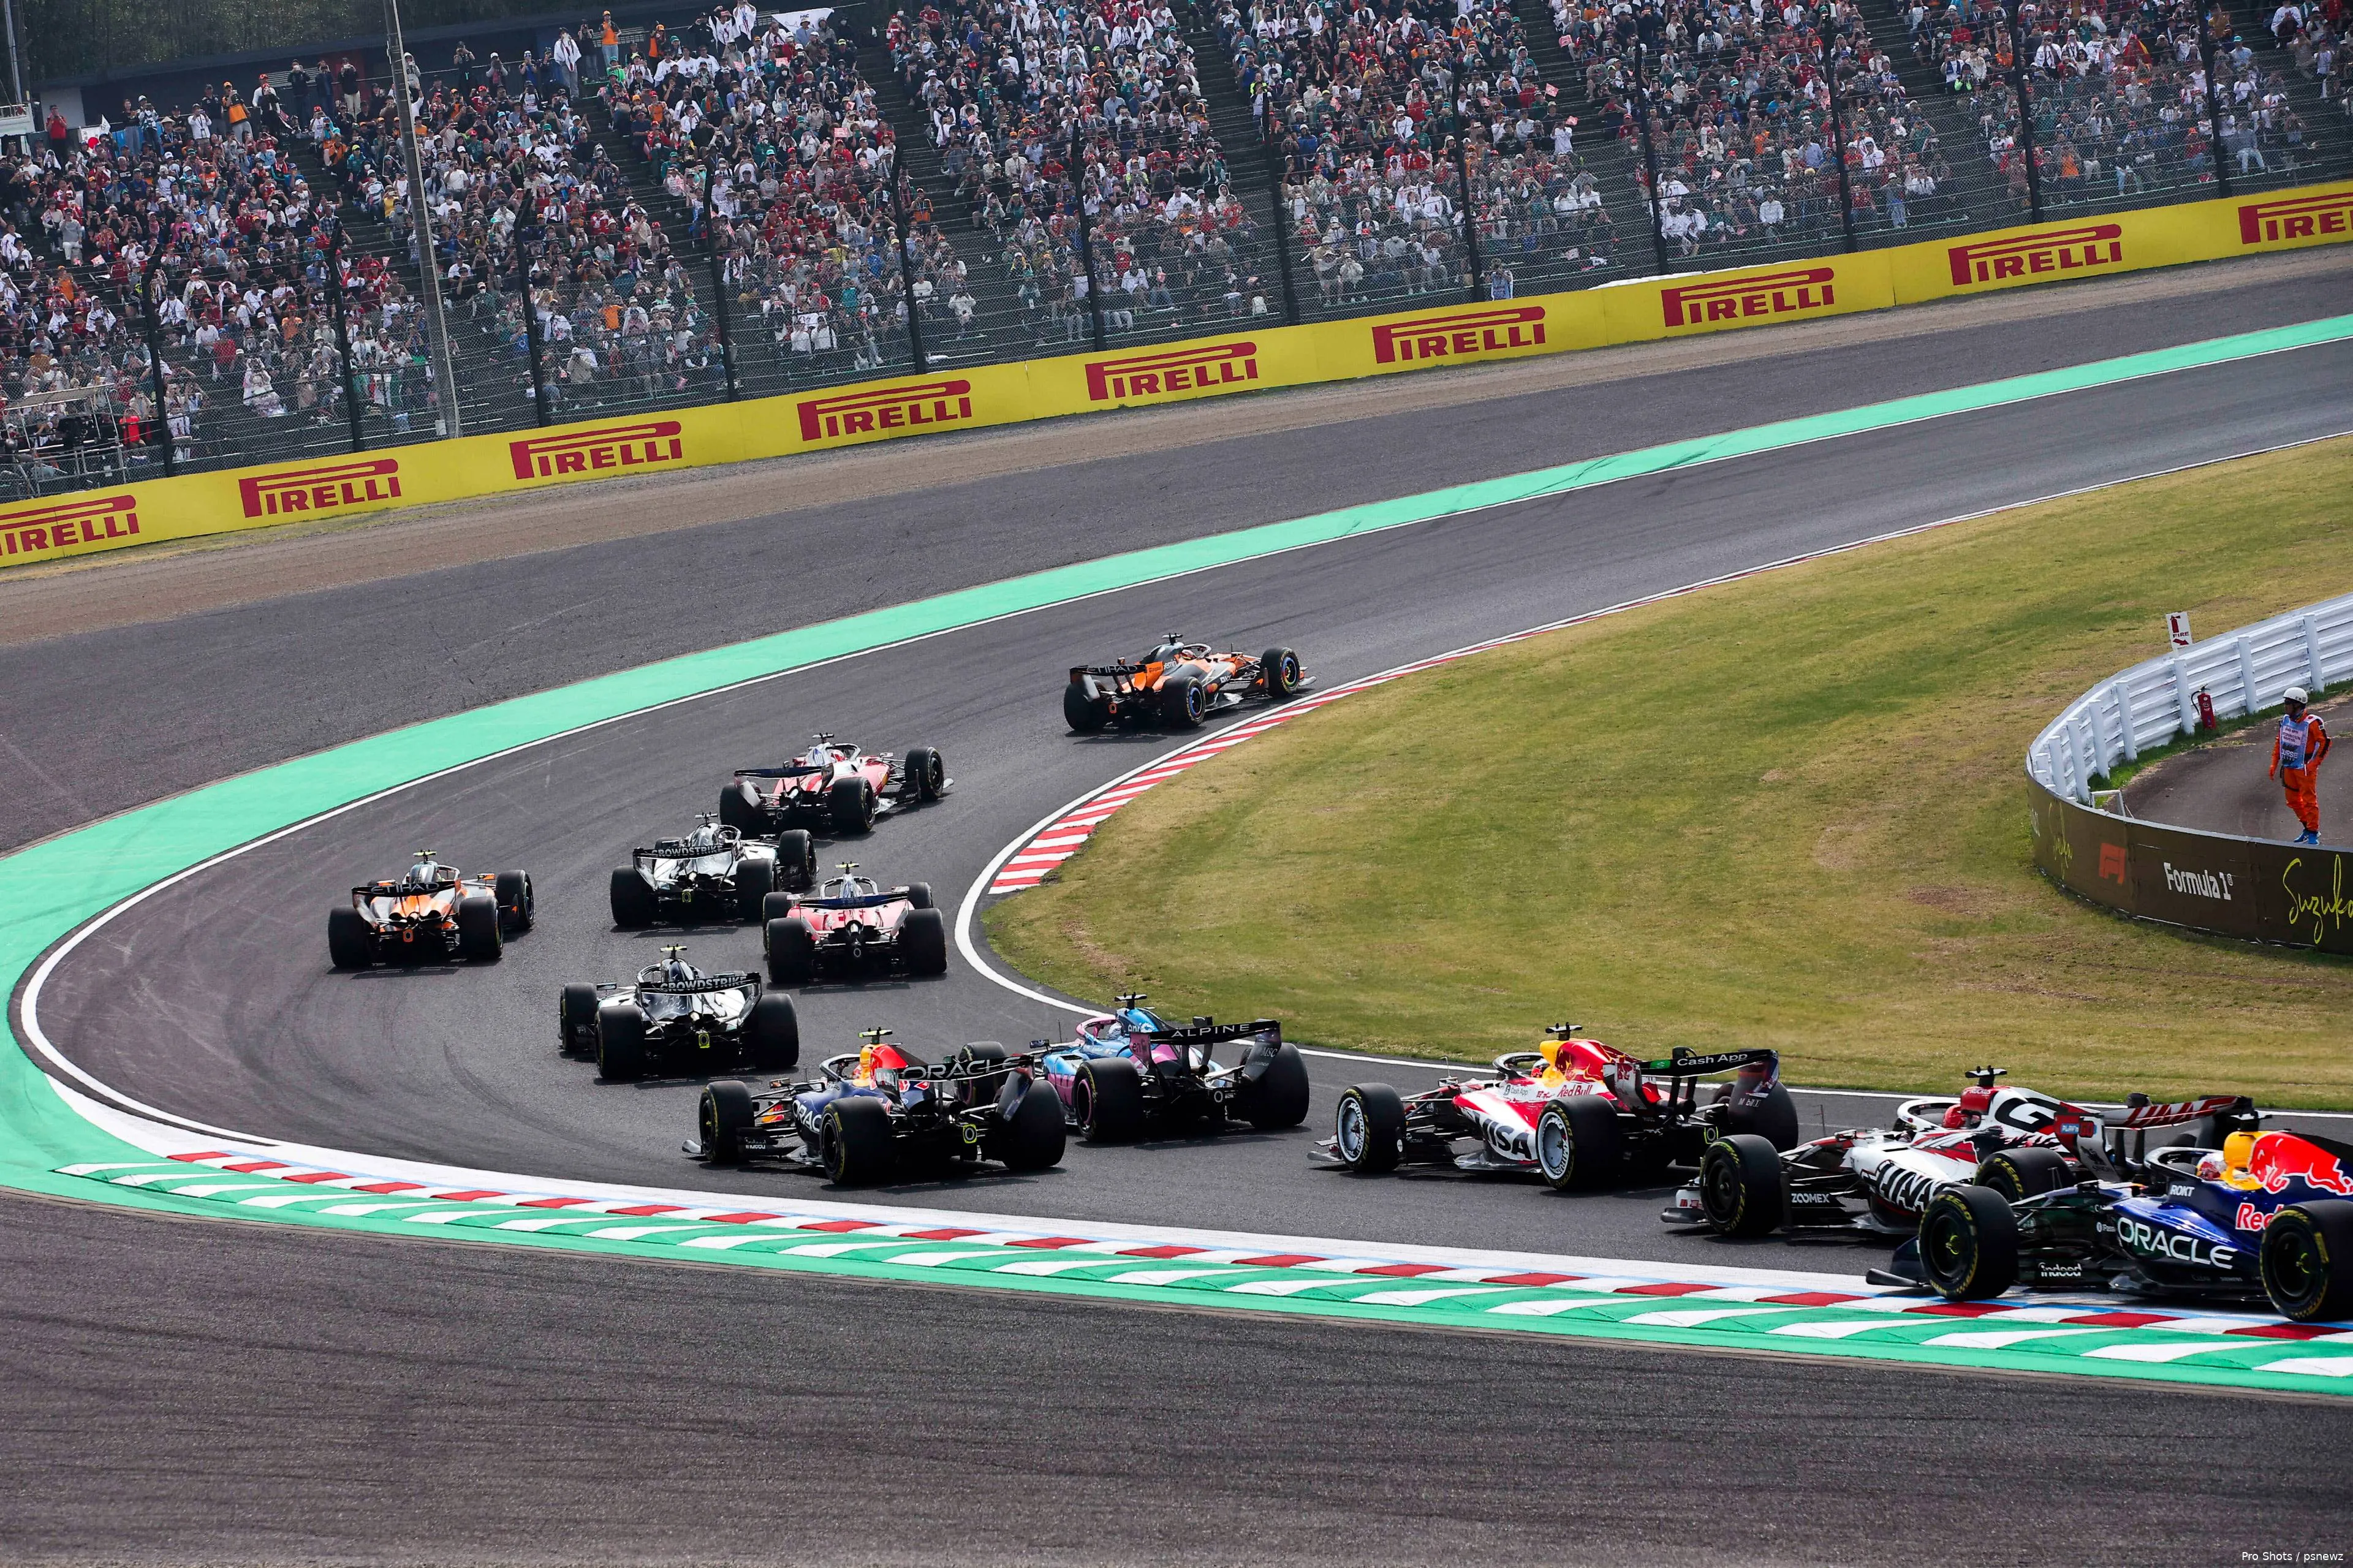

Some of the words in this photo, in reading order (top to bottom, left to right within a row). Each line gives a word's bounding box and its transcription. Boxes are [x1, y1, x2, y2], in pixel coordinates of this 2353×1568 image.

[2240, 193, 2353, 244] PIRE
[1949, 224, 2122, 286] PIRELLI
[1661, 267, 1834, 327] PIRELLI
[1372, 306, 1545, 363] PIRELLI
[1085, 341, 1258, 401] PIRELLI
[798, 379, 972, 441] PIRELLI
[509, 420, 682, 480] PIRELLI
[238, 458, 401, 518] PIRELLI
[651, 845, 724, 858] CROWDSTRIKE
[2164, 862, 2221, 899] Formula
[659, 975, 747, 993] CROWDSTRIKE
[1171, 1023, 1250, 1038] ALPINE
[902, 1056, 1021, 1080] ORACLE
[1677, 1056, 1714, 1066] Cash
[1718, 1052, 1748, 1062] App
[1557, 1084, 1575, 1097] Red
[1575, 1084, 1593, 1097] Bull
[792, 1099, 823, 1133] ORAC
[1468, 1109, 1532, 1160] VISA
[1791, 1193, 1830, 1204] ZOOMEX
[2171, 1184, 2195, 1197] ROKT
[2118, 1217, 2238, 1270] ORACLE
